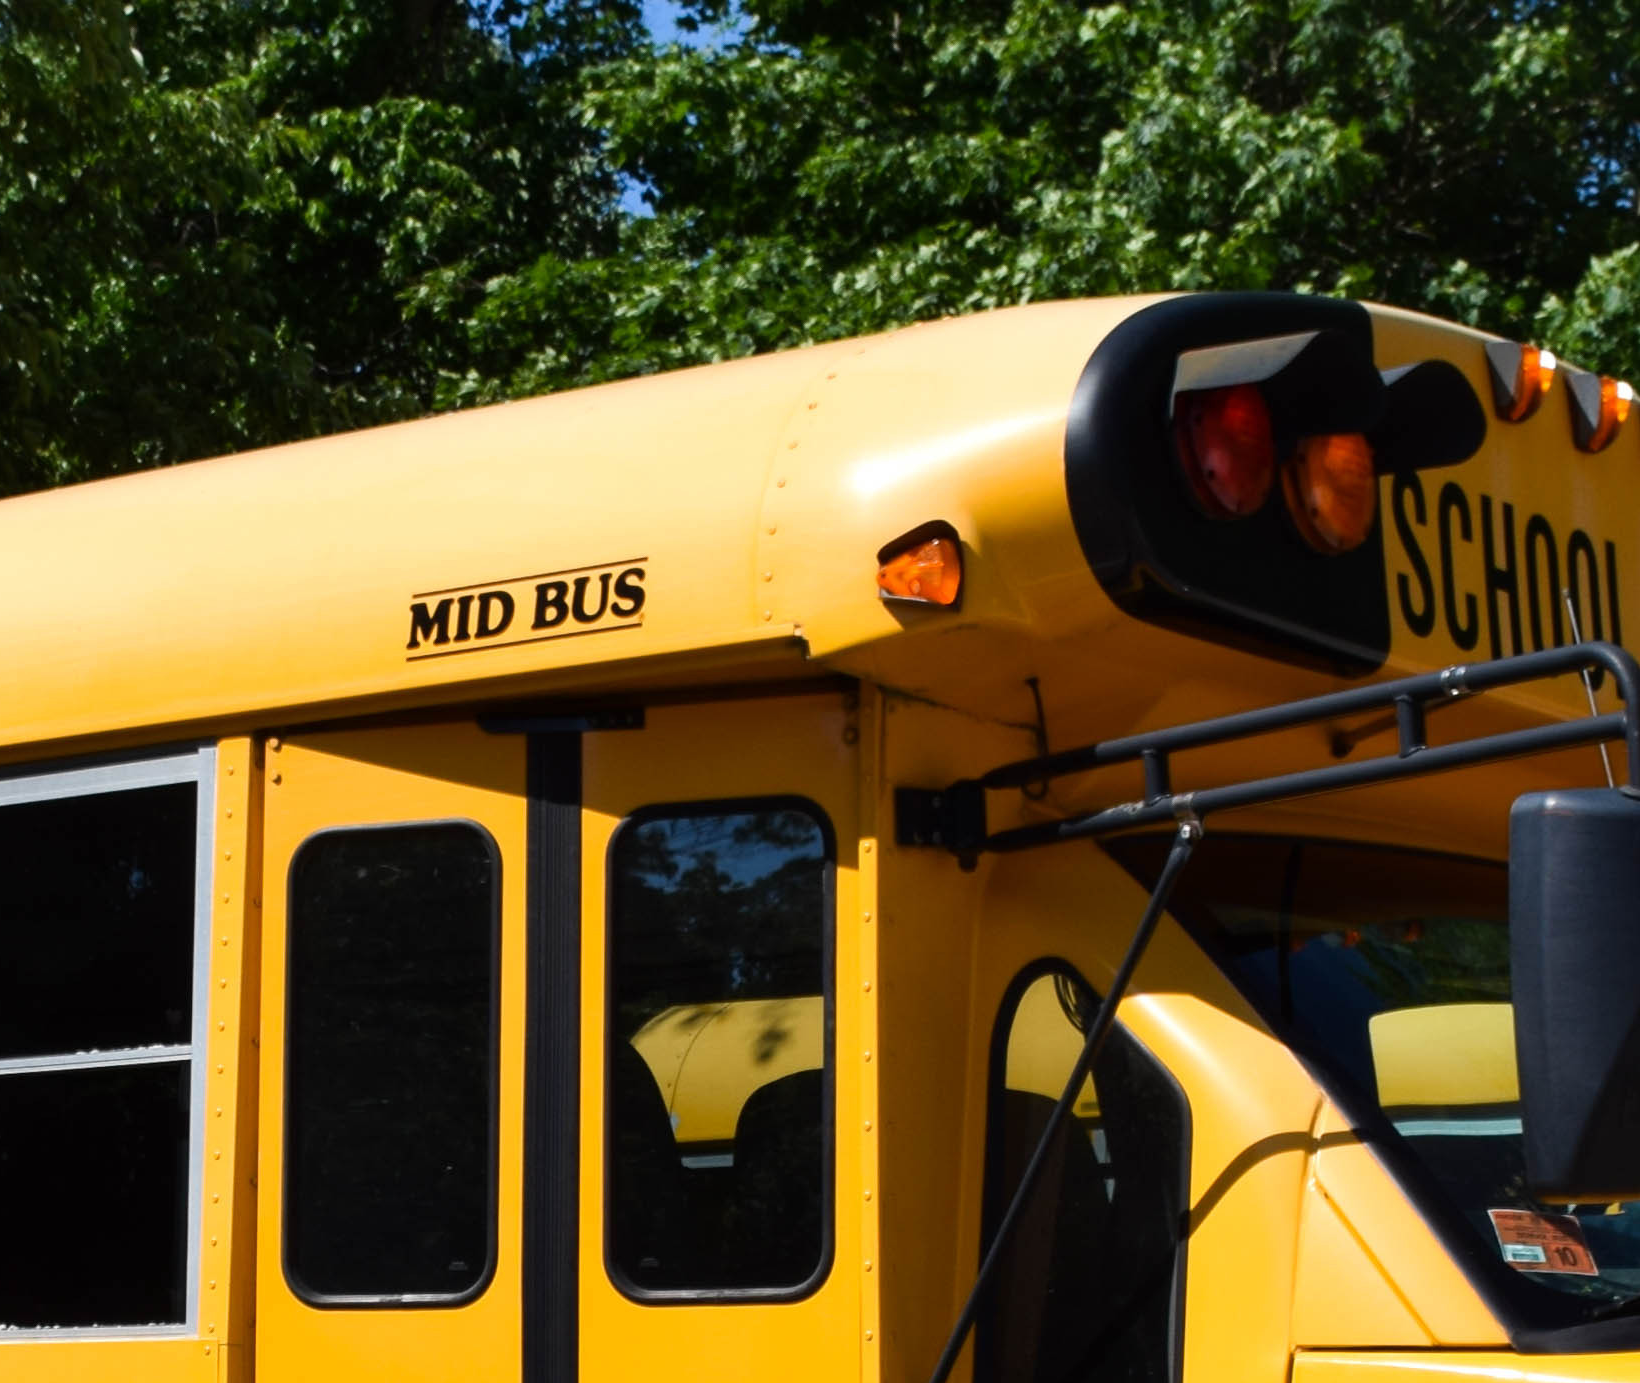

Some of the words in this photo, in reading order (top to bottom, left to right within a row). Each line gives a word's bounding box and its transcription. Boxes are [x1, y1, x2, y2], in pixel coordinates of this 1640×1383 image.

[406, 590, 515, 649] MID
[531, 567, 646, 631] BUS
[1391, 471, 1627, 702] SCHOOL
